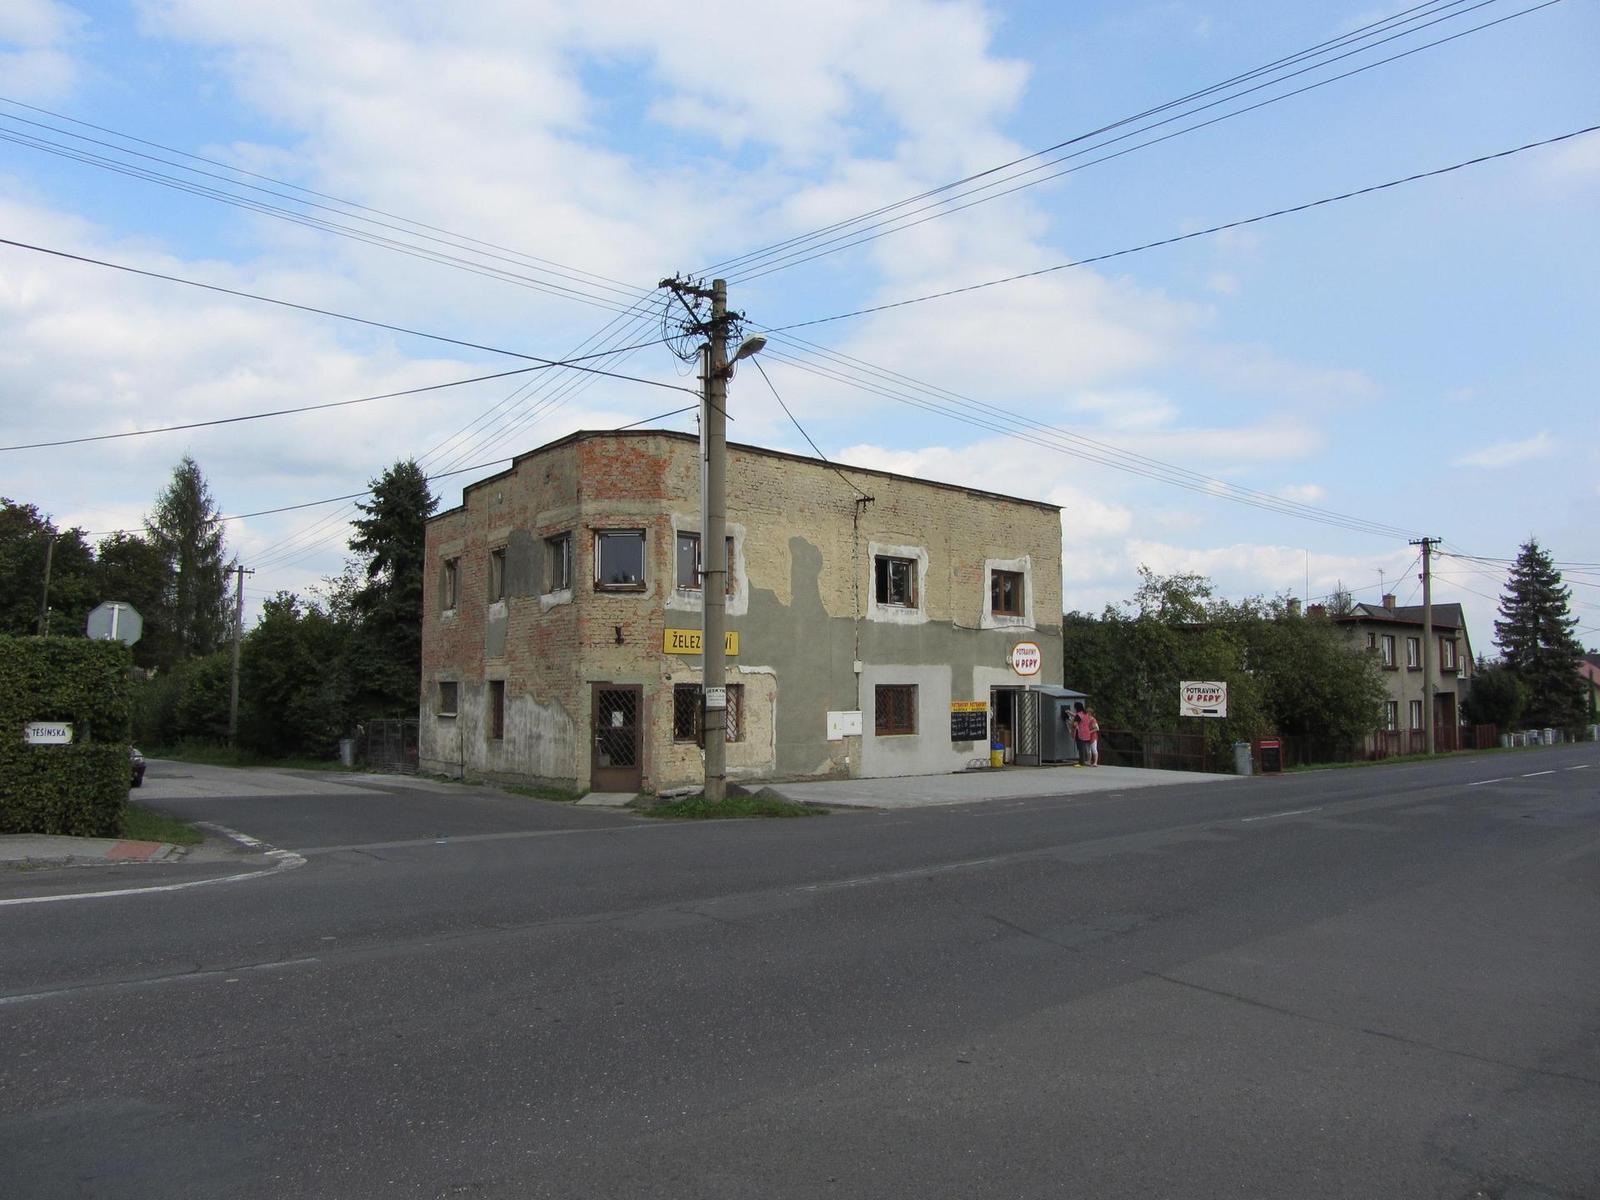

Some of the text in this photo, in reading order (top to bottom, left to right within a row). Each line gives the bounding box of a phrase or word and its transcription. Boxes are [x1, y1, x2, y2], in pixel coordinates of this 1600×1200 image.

[1015, 659, 1038, 669] U PEPY
[1187, 694, 1221, 702] U PEPY
